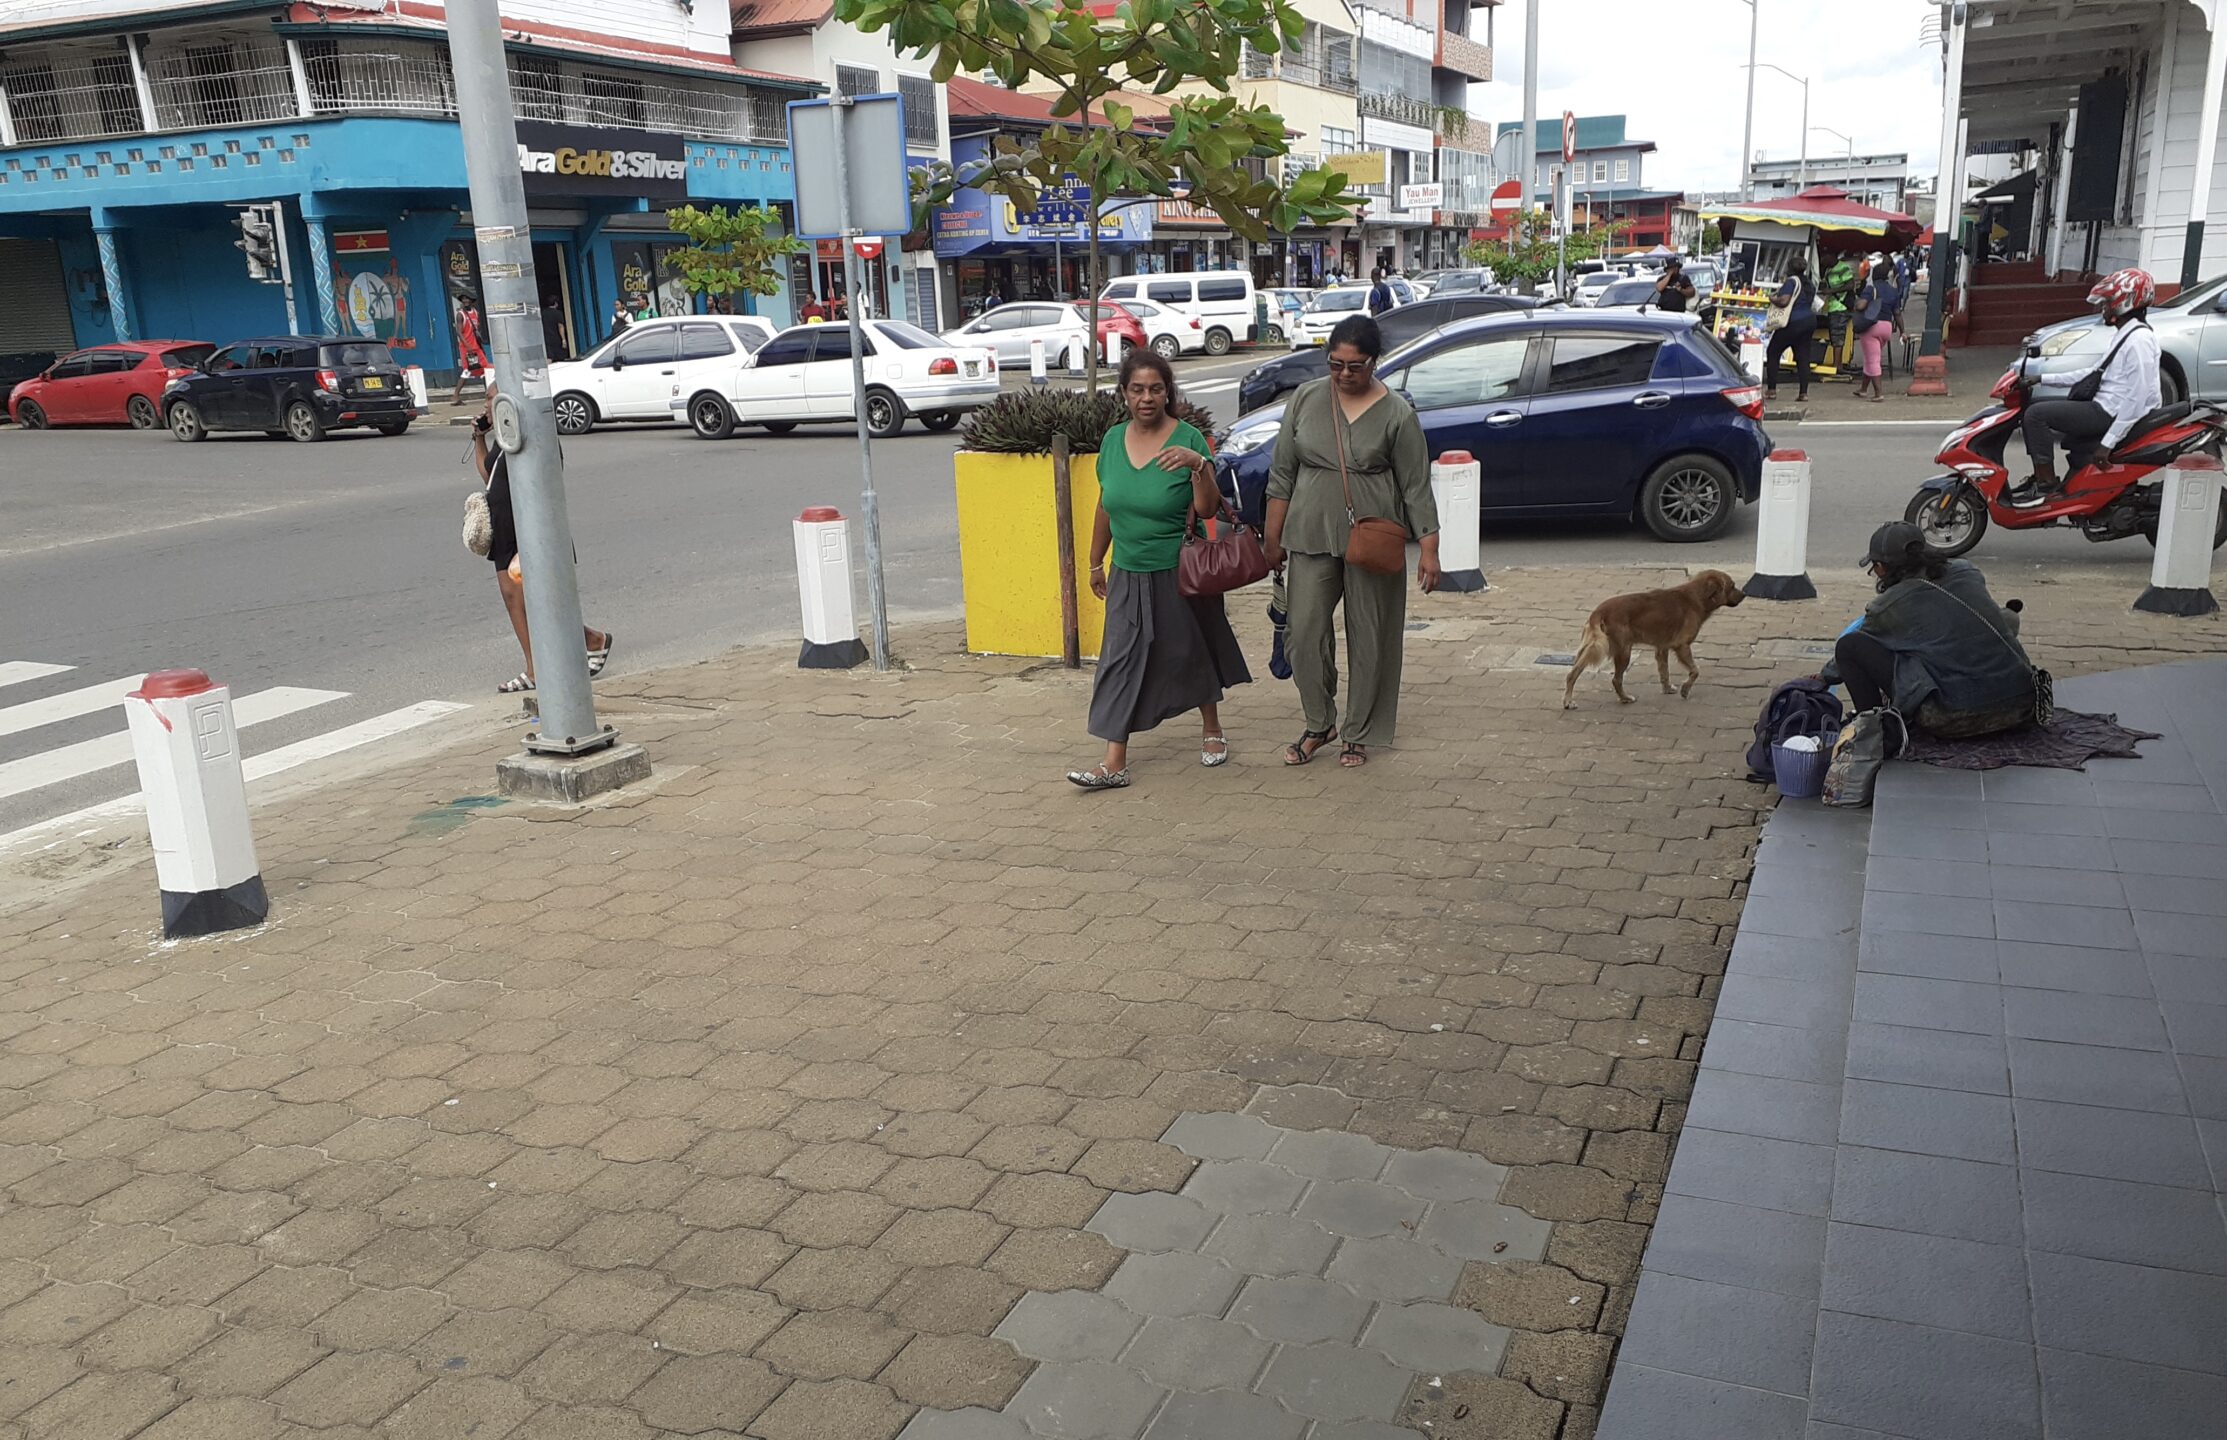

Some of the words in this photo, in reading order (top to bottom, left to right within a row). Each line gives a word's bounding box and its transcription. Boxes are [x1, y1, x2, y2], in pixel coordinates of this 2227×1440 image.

[1405, 187, 1420, 198] Yau
[1422, 186, 1439, 197] Man
[450, 251, 465, 261] Ara
[450, 260, 469, 271] Gold
[623, 263, 642, 278] Ara
[623, 278, 648, 292] Gold
